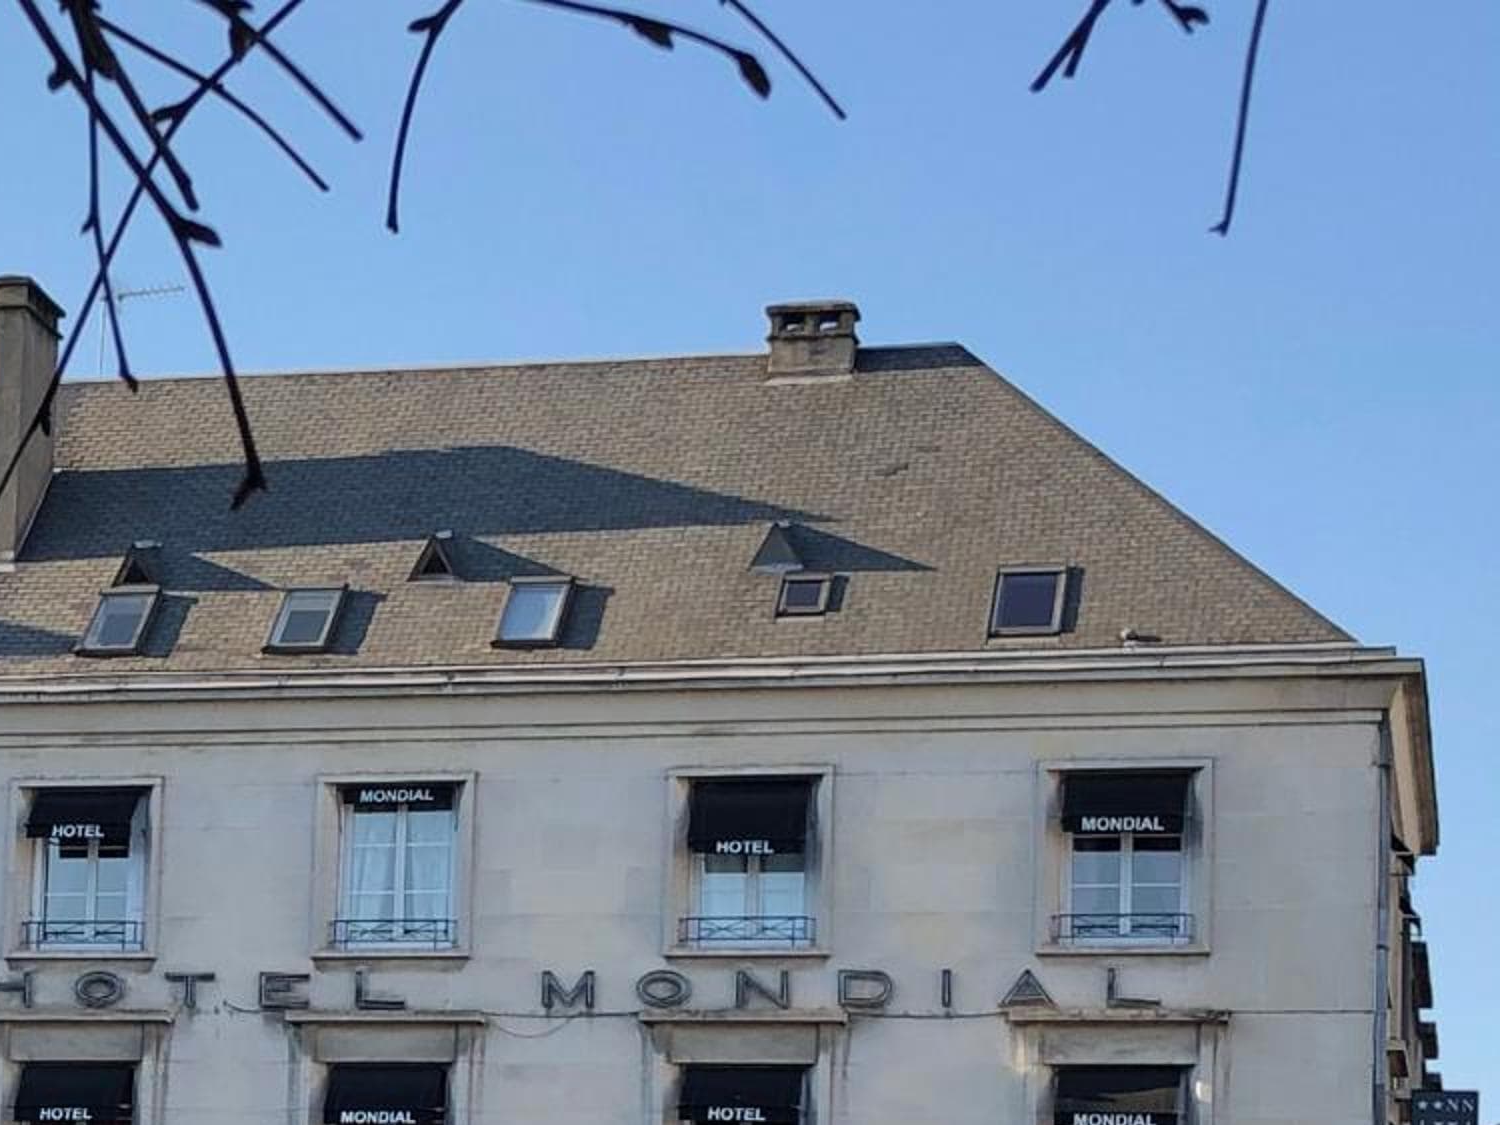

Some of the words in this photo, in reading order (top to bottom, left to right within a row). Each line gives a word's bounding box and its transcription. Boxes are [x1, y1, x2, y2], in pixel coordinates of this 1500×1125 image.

[359, 786, 435, 804] MONDIAL
[51, 823, 105, 839] HOTEL
[1080, 815, 1165, 832] MONDIAL
[715, 839, 775, 855] HOTEL
[541, 968, 1163, 1010] MONDIAL
[38, 1106, 93, 1122] HOTEL
[340, 1108, 416, 1125] MONDIAL
[707, 1106, 766, 1122] HOTEL
